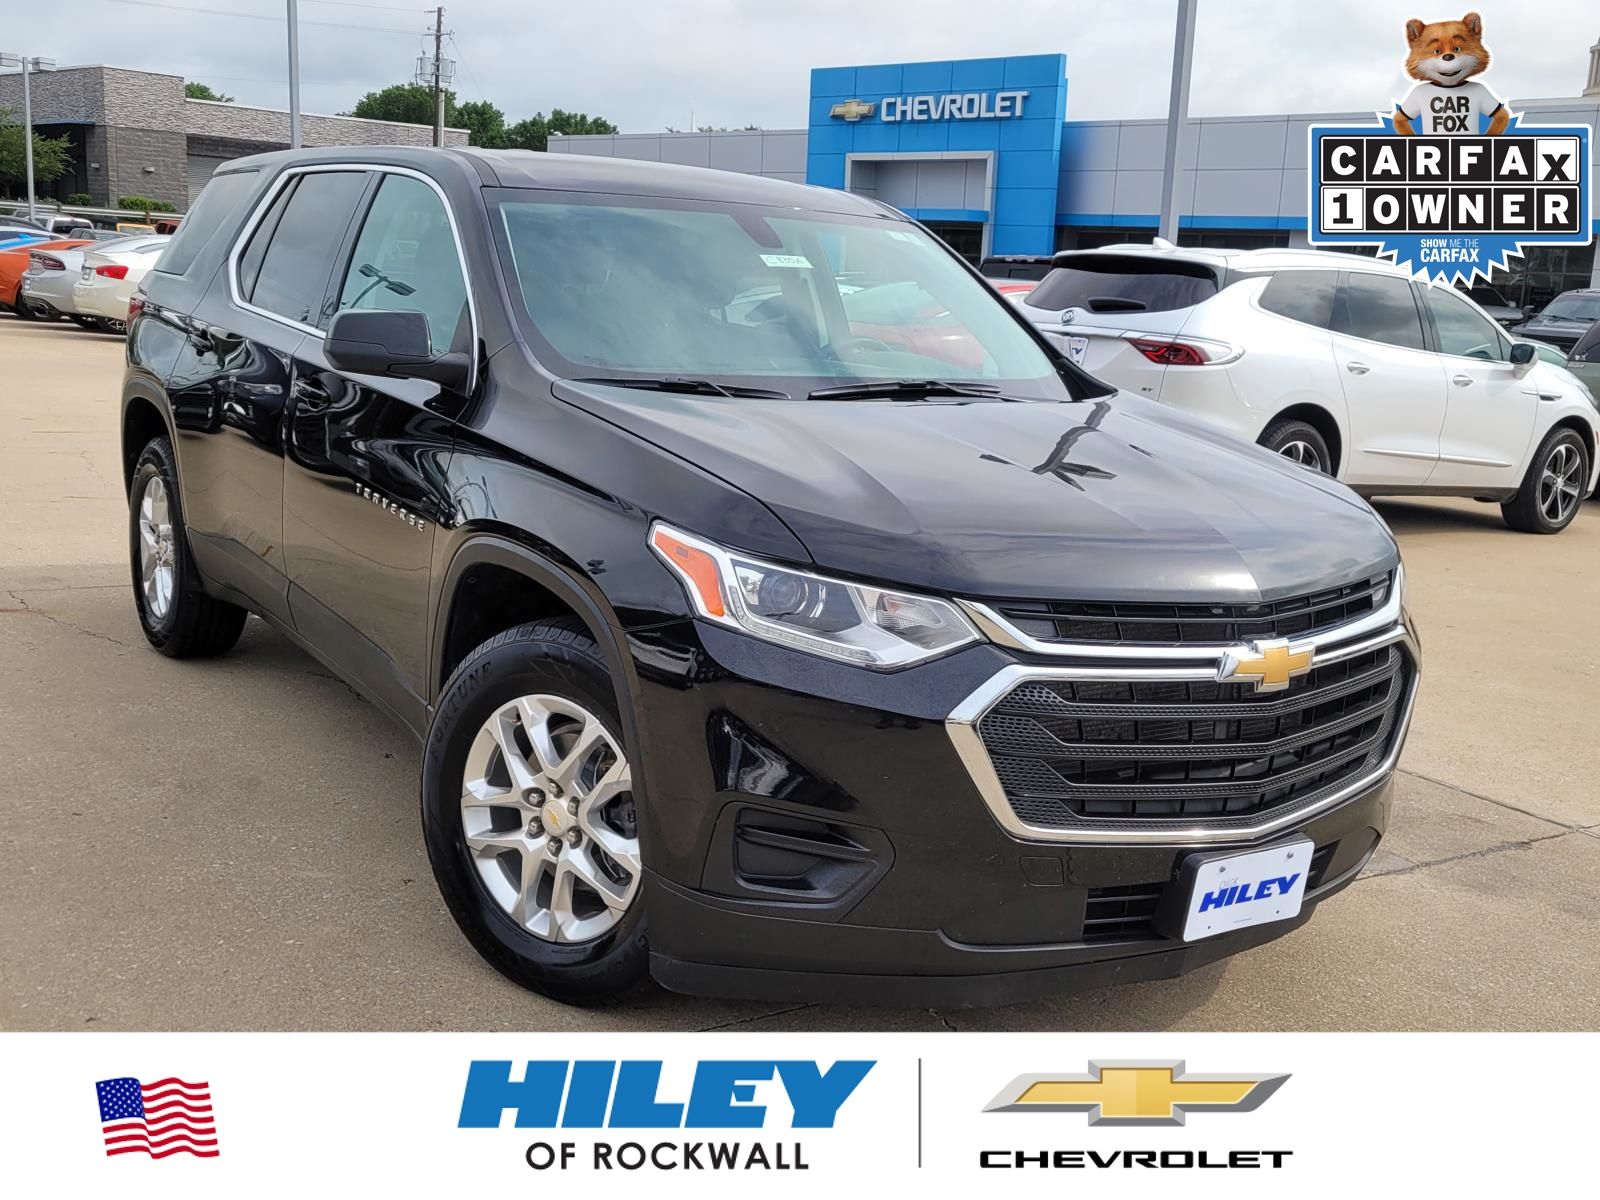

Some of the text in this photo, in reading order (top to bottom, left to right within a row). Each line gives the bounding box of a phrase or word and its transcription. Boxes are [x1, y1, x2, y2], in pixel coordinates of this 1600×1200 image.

[880, 90, 1029, 122] CHEVROLET
[355, 482, 425, 532] TRAVERSE
[1198, 872, 1302, 913] HILEY
